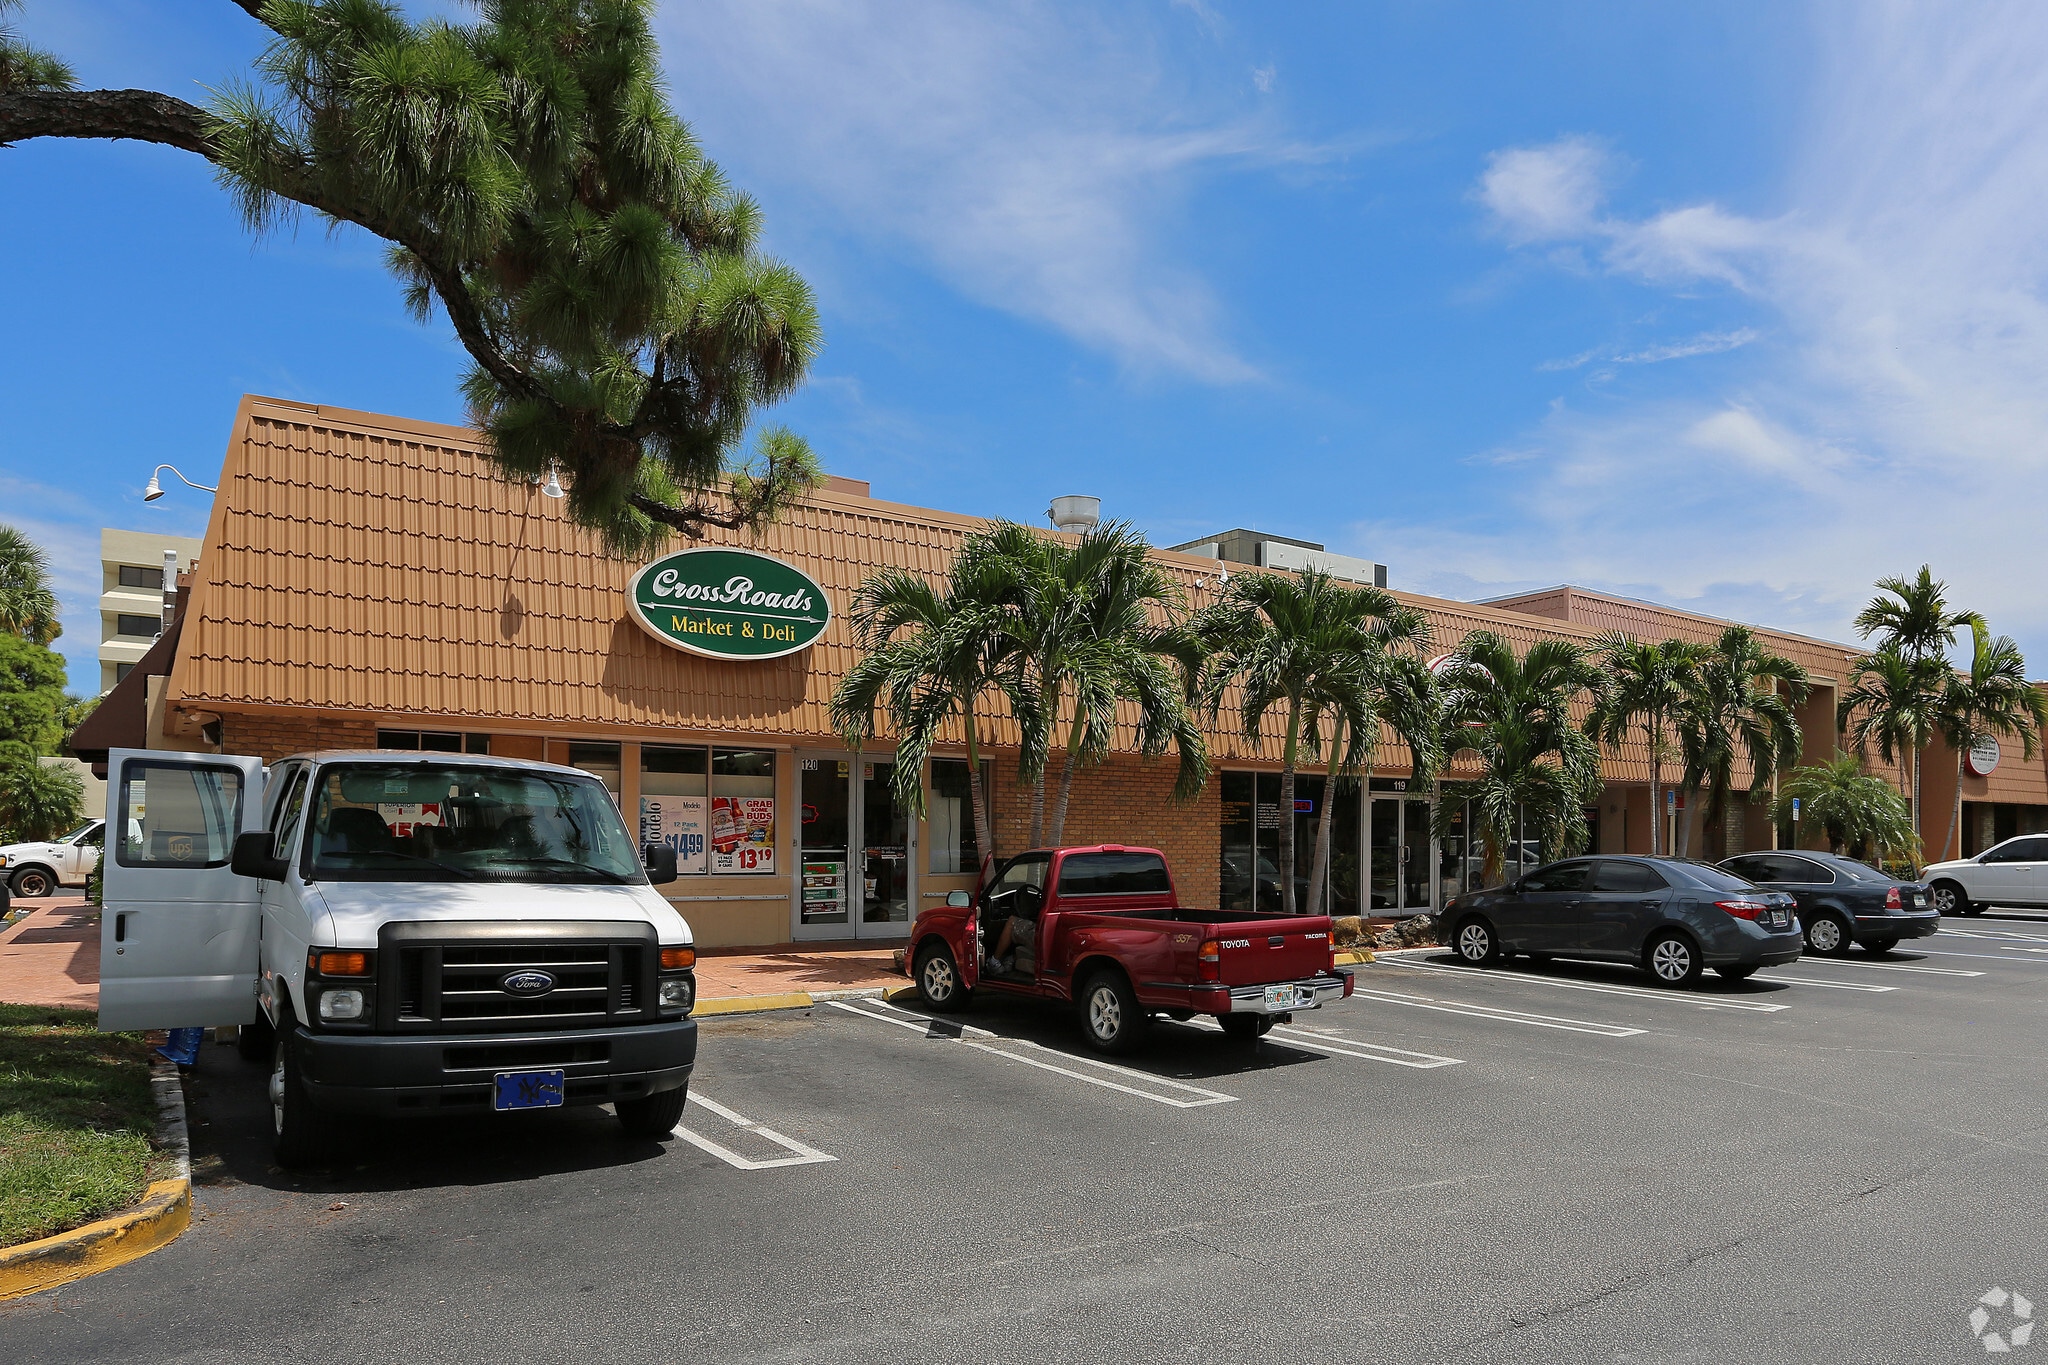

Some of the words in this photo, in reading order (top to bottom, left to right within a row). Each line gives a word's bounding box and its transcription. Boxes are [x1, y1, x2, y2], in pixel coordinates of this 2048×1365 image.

[671, 615, 734, 637] Market
[741, 621, 755, 639] &
[762, 623, 796, 642] Deli
[801, 760, 818, 770] 120
[1393, 780, 1406, 791] 119
[682, 801, 701, 810] Modelo
[746, 800, 773, 808] GRAB
[1294, 801, 1311, 810] PEN
[746, 812, 773, 820] BUDS
[645, 802, 663, 844] odelo
[170, 842, 191, 857] ups
[1304, 932, 1327, 940] TACOMA
[1220, 939, 1250, 949] TOYOTA
[515, 976, 542, 988] Ford
